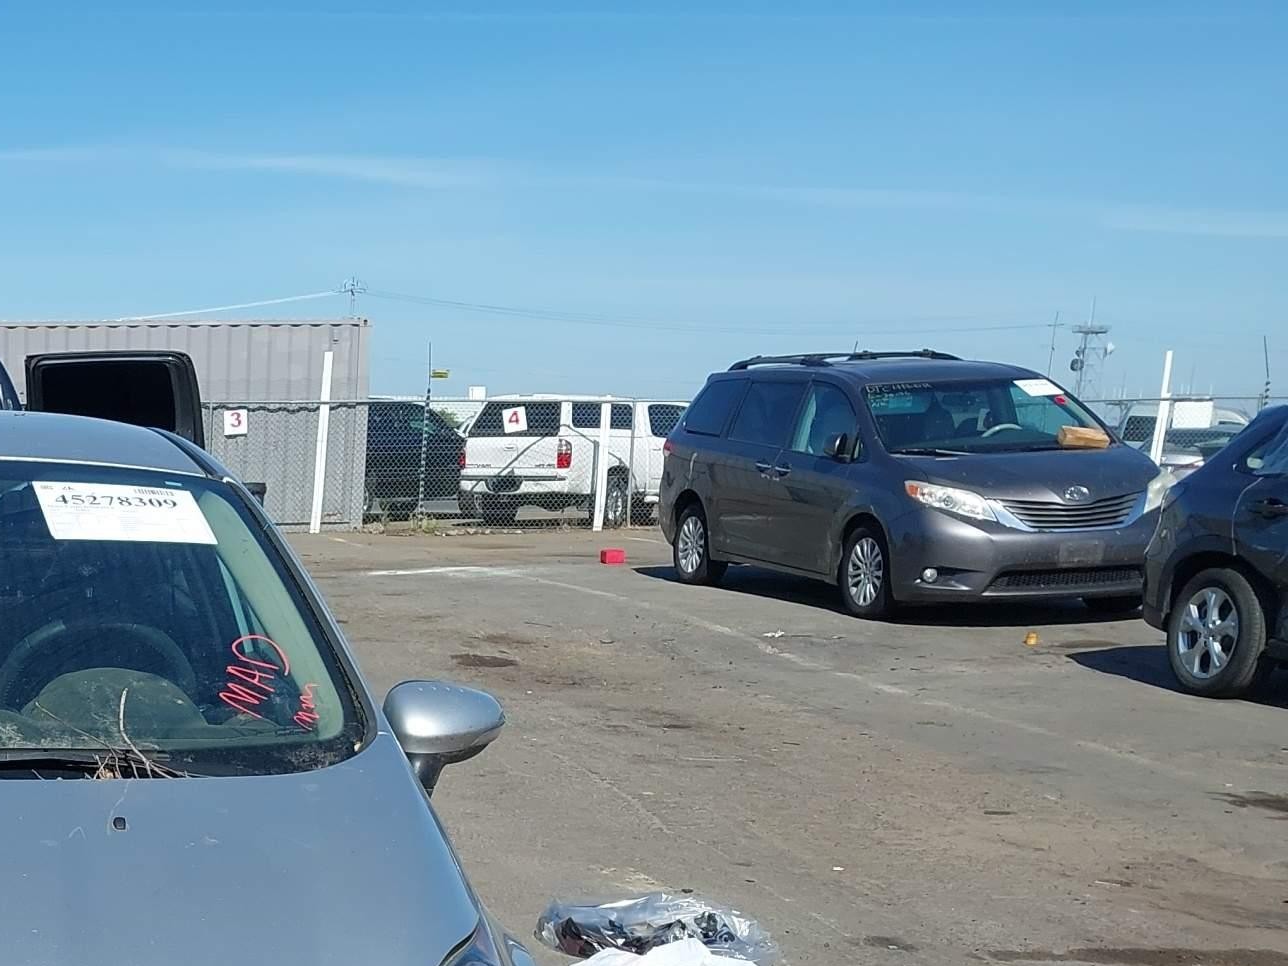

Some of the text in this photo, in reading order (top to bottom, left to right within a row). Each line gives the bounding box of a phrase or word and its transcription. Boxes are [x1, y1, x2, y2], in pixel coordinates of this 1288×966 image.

[230, 411, 242, 428] 3
[508, 410, 520, 425] 4
[55, 493, 178, 509] 45278309
